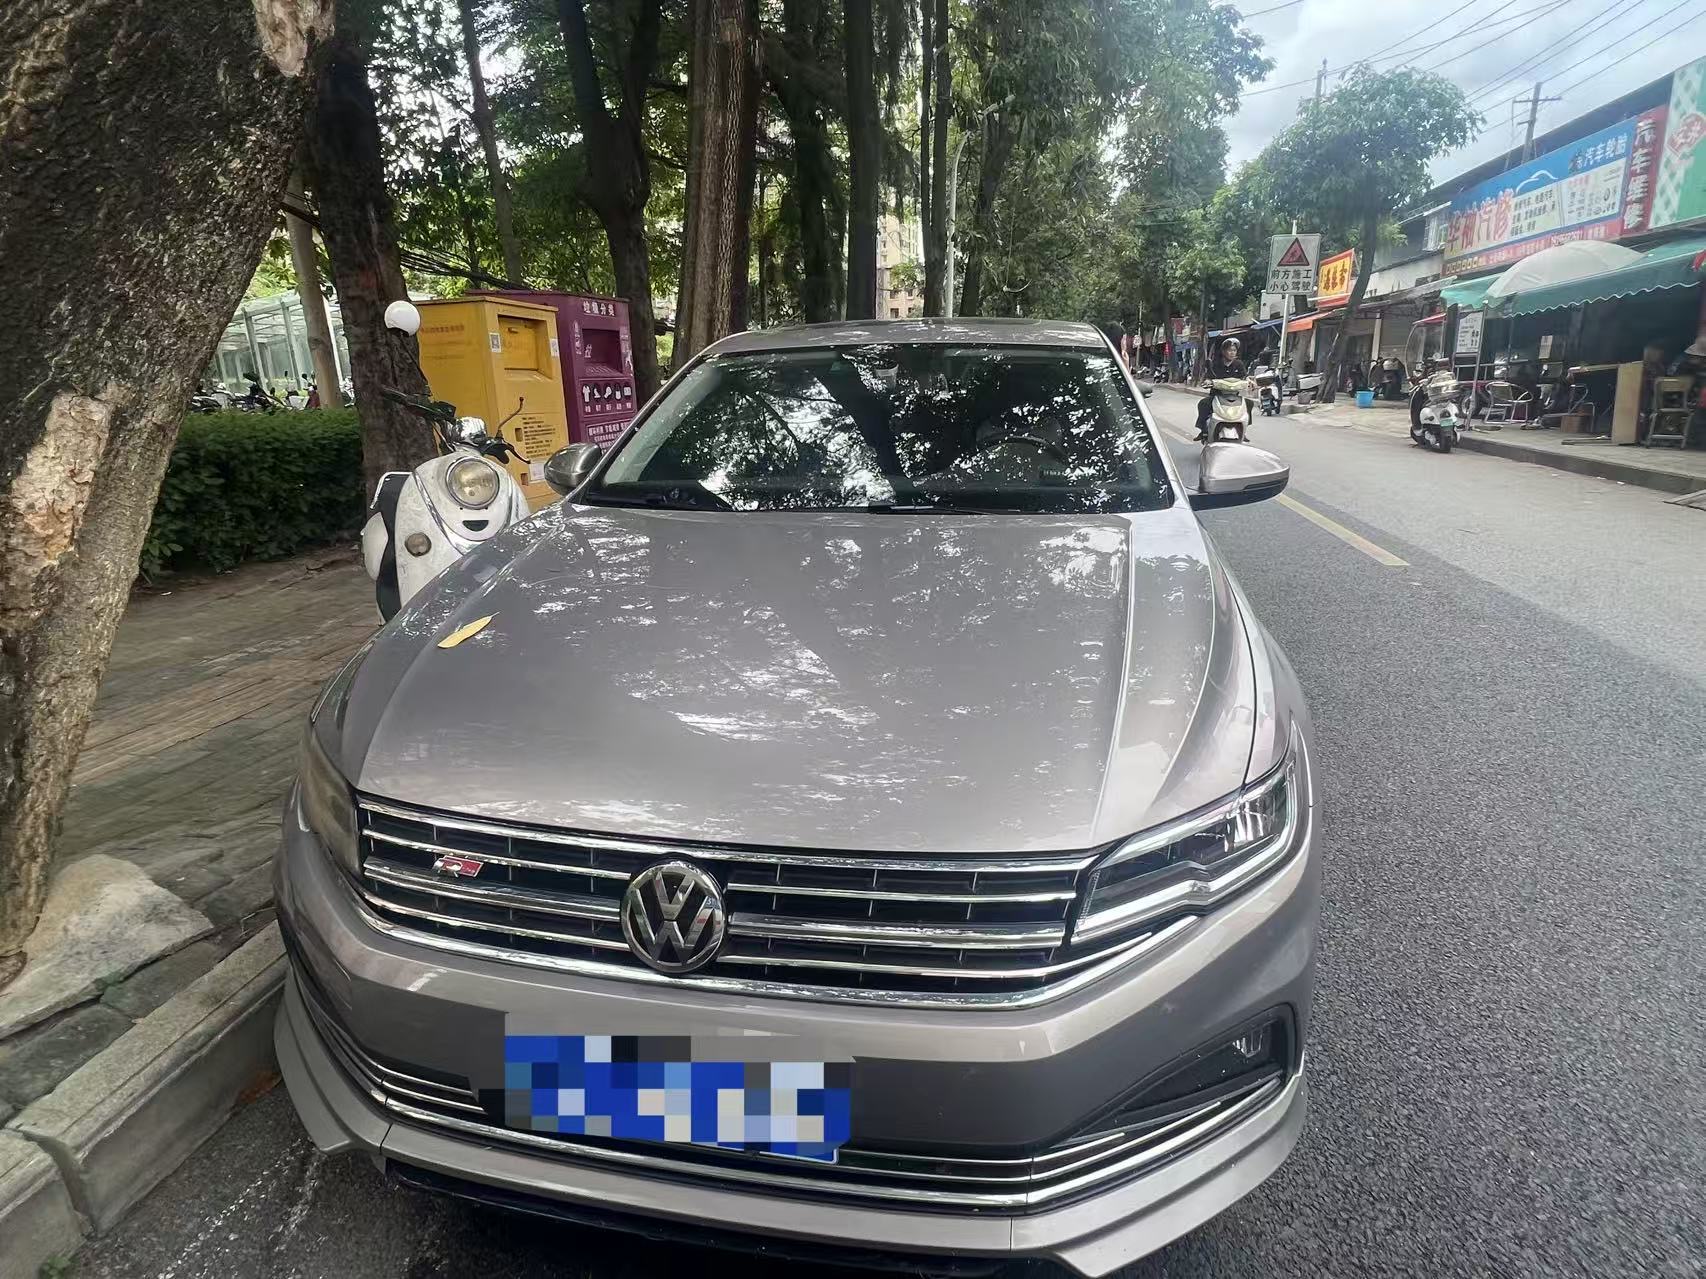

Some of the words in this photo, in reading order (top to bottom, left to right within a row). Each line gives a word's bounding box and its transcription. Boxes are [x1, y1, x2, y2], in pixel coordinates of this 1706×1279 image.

[1624, 119, 1656, 229] 汽车维修
[1270, 281, 1311, 292] 小心驾驶
[583, 300, 616, 317] 垃圾分类
